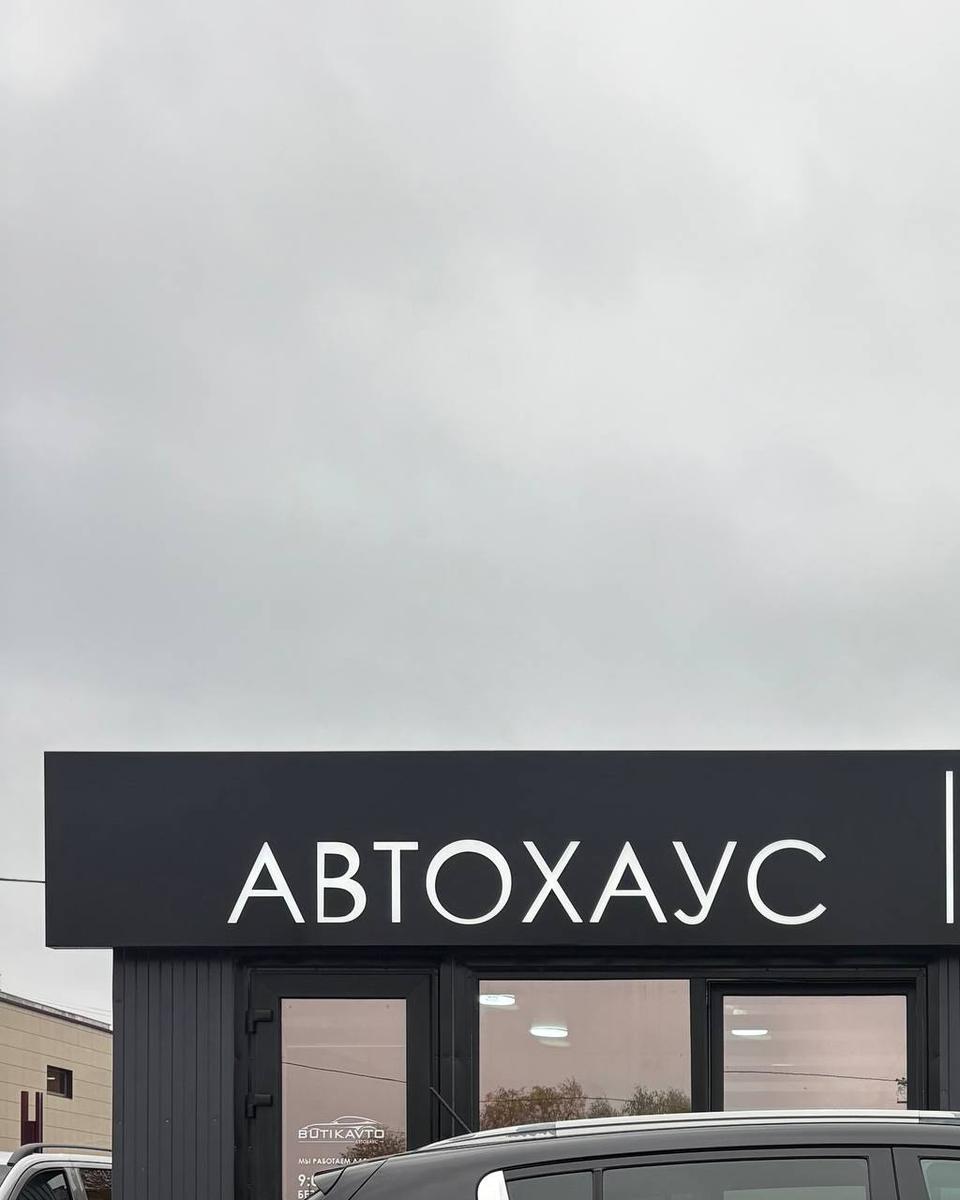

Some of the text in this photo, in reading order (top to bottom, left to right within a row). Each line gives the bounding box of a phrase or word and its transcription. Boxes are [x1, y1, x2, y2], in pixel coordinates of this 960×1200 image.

[227, 839, 827, 925] АВТОХАУС
[298, 1128, 385, 1139] BUTIKAVTO
[298, 1157, 311, 1165] МЫ
[312, 1157, 351, 1166] РАБОТАЕМ
